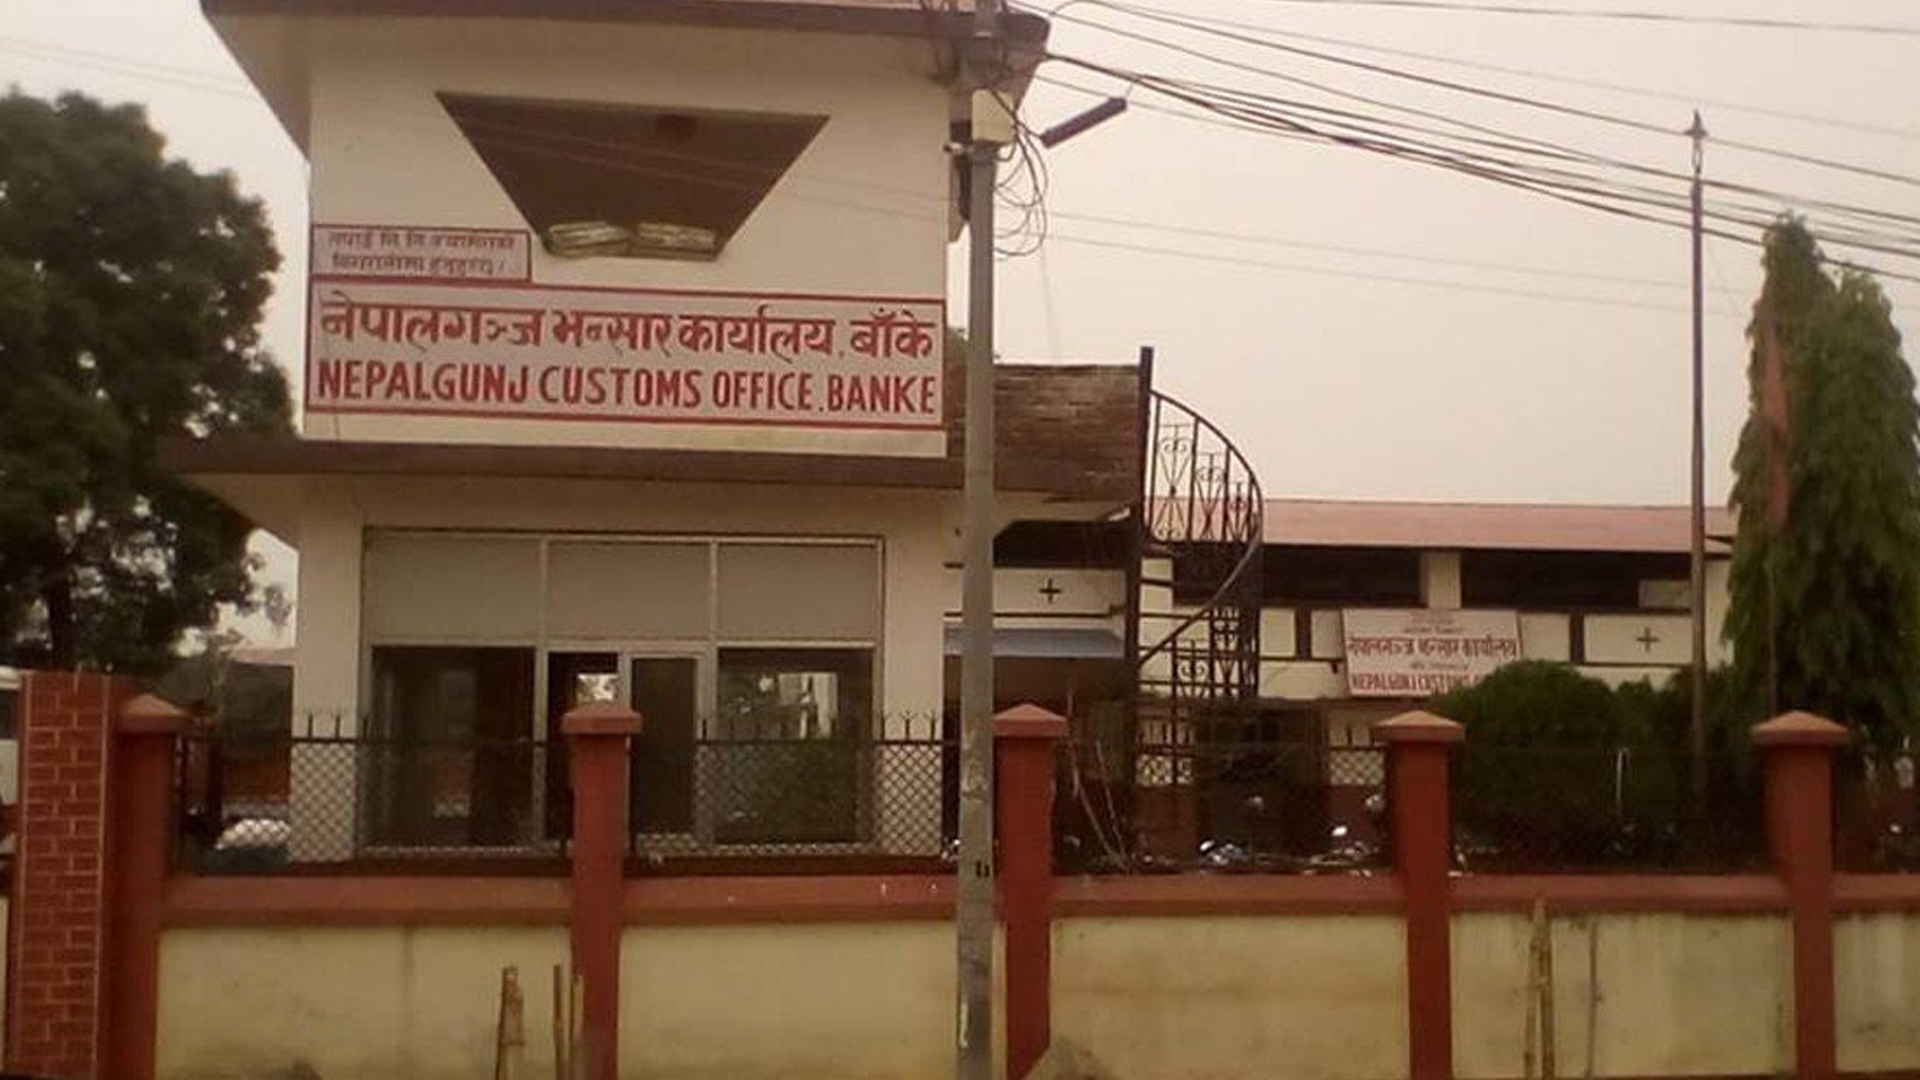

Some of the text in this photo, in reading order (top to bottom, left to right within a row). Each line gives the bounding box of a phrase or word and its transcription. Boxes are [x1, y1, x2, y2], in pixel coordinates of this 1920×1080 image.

[320, 290, 545, 352] नेपालगञ्ज
[551, 310, 671, 357] भन्सार
[850, 307, 936, 358] बाँके
[318, 359, 528, 403] NEPALGUNJ
[539, 366, 702, 407] CUSTOMS
[827, 374, 936, 414] BANKE
